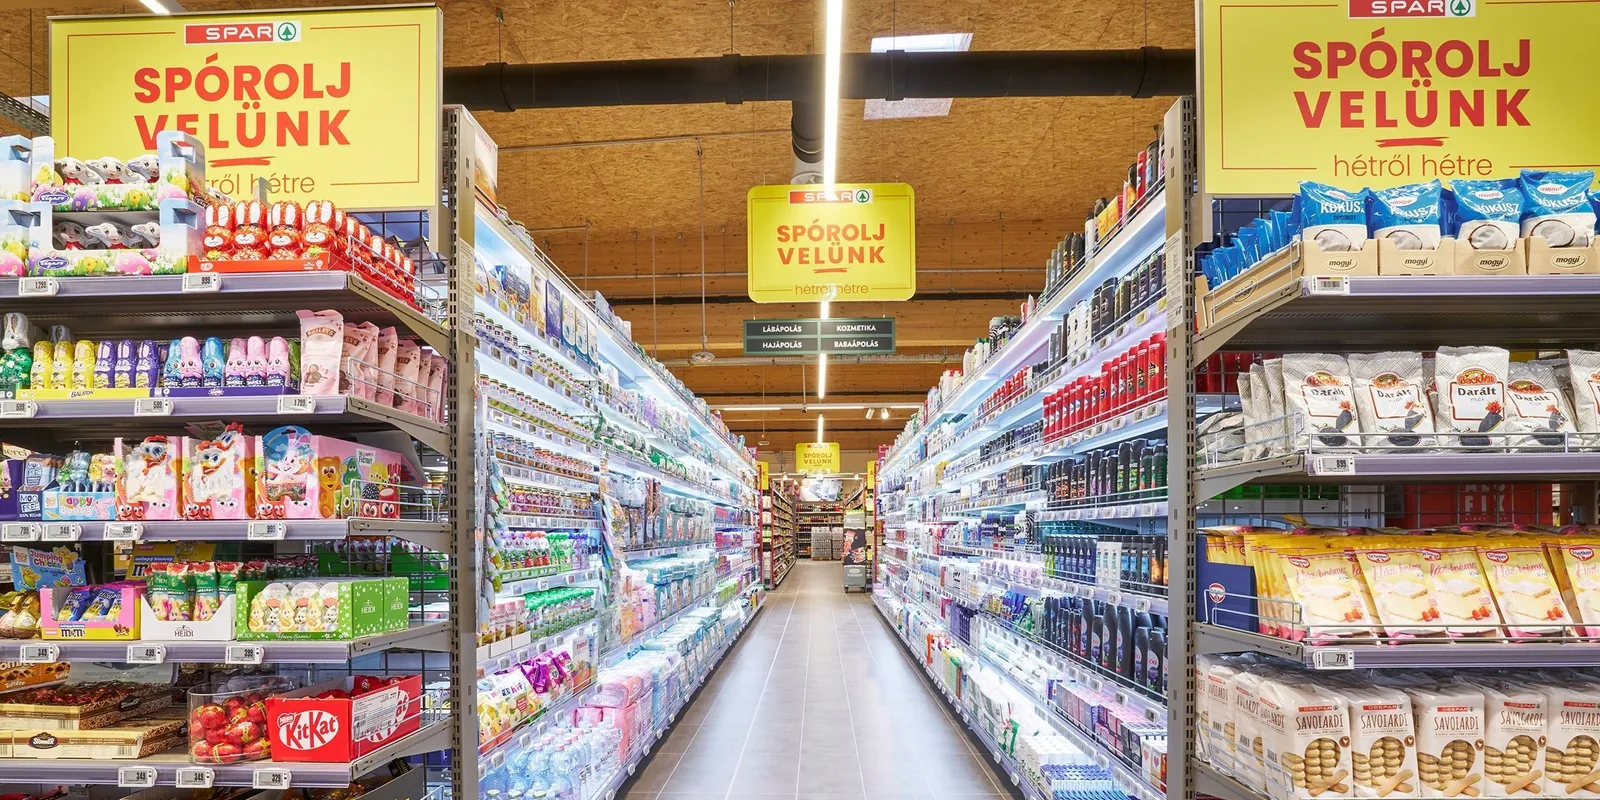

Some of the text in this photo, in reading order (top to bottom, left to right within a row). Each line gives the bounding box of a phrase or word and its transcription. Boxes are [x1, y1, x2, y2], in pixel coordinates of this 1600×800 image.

[1371, 0, 1445, 14] SPAR
[206, 25, 273, 40] SPAR
[1293, 27, 1531, 79] SPÓROLJ
[134, 53, 352, 104] SPÓROLJ
[1293, 78, 1532, 128] VELÜNK
[1334, 154, 1493, 177] hétről hétre
[776, 218, 886, 242] SPÓROLJ
[778, 242, 886, 265] VELÜNK
[1328, 258, 1352, 268] mogyi
[1404, 258, 1428, 266] mogyi
[1480, 258, 1504, 266] mogyi
[1556, 256, 1580, 264] mogyi
[762, 325, 802, 334] LÁBÁPOLÁS
[762, 341, 802, 349] HAJÁPOLÁS
[834, 340, 879, 348] BABAÁPOLÁS
[1311, 387, 1346, 397] Darált
[1378, 388, 1412, 399] Darált
[1458, 386, 1496, 396] Darált
[1516, 394, 1551, 402] Darált
[1336, 460, 1347, 468] 899
[20, 494, 38, 503] MOO
[59, 494, 93, 507] Happy
[60, 506, 93, 518] Bunny
[60, 526, 70, 535] 349
[29, 548, 64, 563] Jumping
[1399, 563, 1422, 572] kréme
[361, 606, 376, 614] HEIDI
[38, 648, 47, 657] 349
[145, 649, 154, 657] 499
[1336, 654, 1346, 663] 779
[1296, 714, 1344, 731] SAVOIARDI
[1360, 712, 1408, 730] SAVOIARDI
[1434, 716, 1479, 731] SAVOIARDI
[1500, 710, 1544, 727] SAVOIARDI
[286, 712, 336, 748] KitKat
[136, 772, 146, 780] 349
[194, 772, 204, 781] 349
